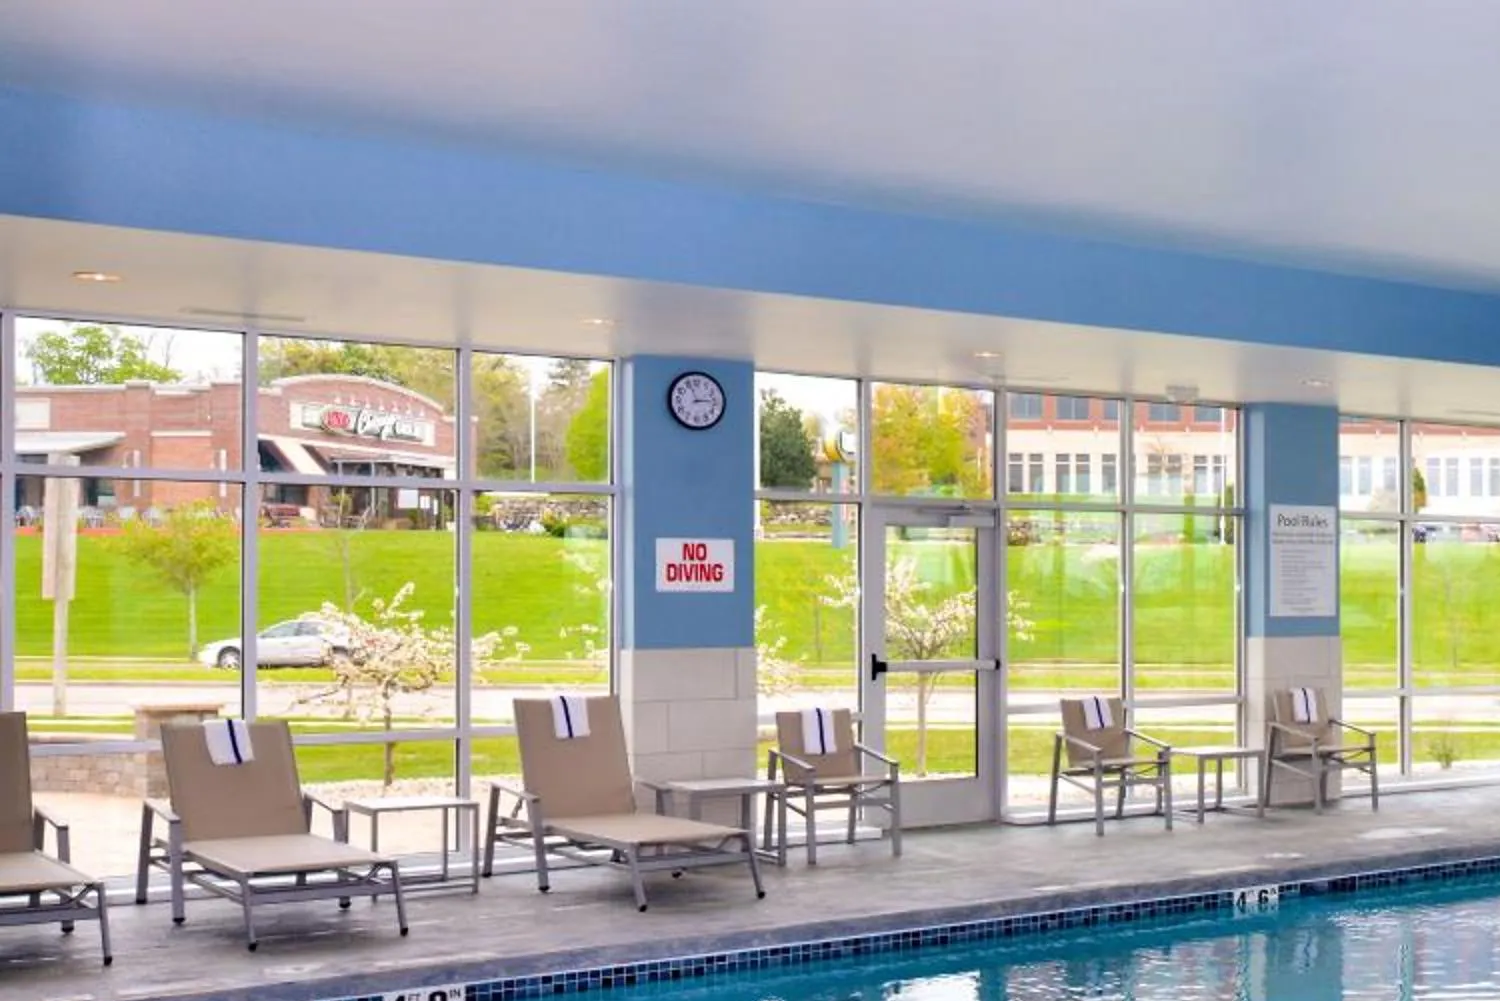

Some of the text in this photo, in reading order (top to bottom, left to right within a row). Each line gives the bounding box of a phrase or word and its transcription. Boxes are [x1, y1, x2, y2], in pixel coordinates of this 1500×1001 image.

[1277, 513, 1329, 528] Pool Rules
[683, 543, 707, 561] NO
[667, 563, 723, 582] DIVING
